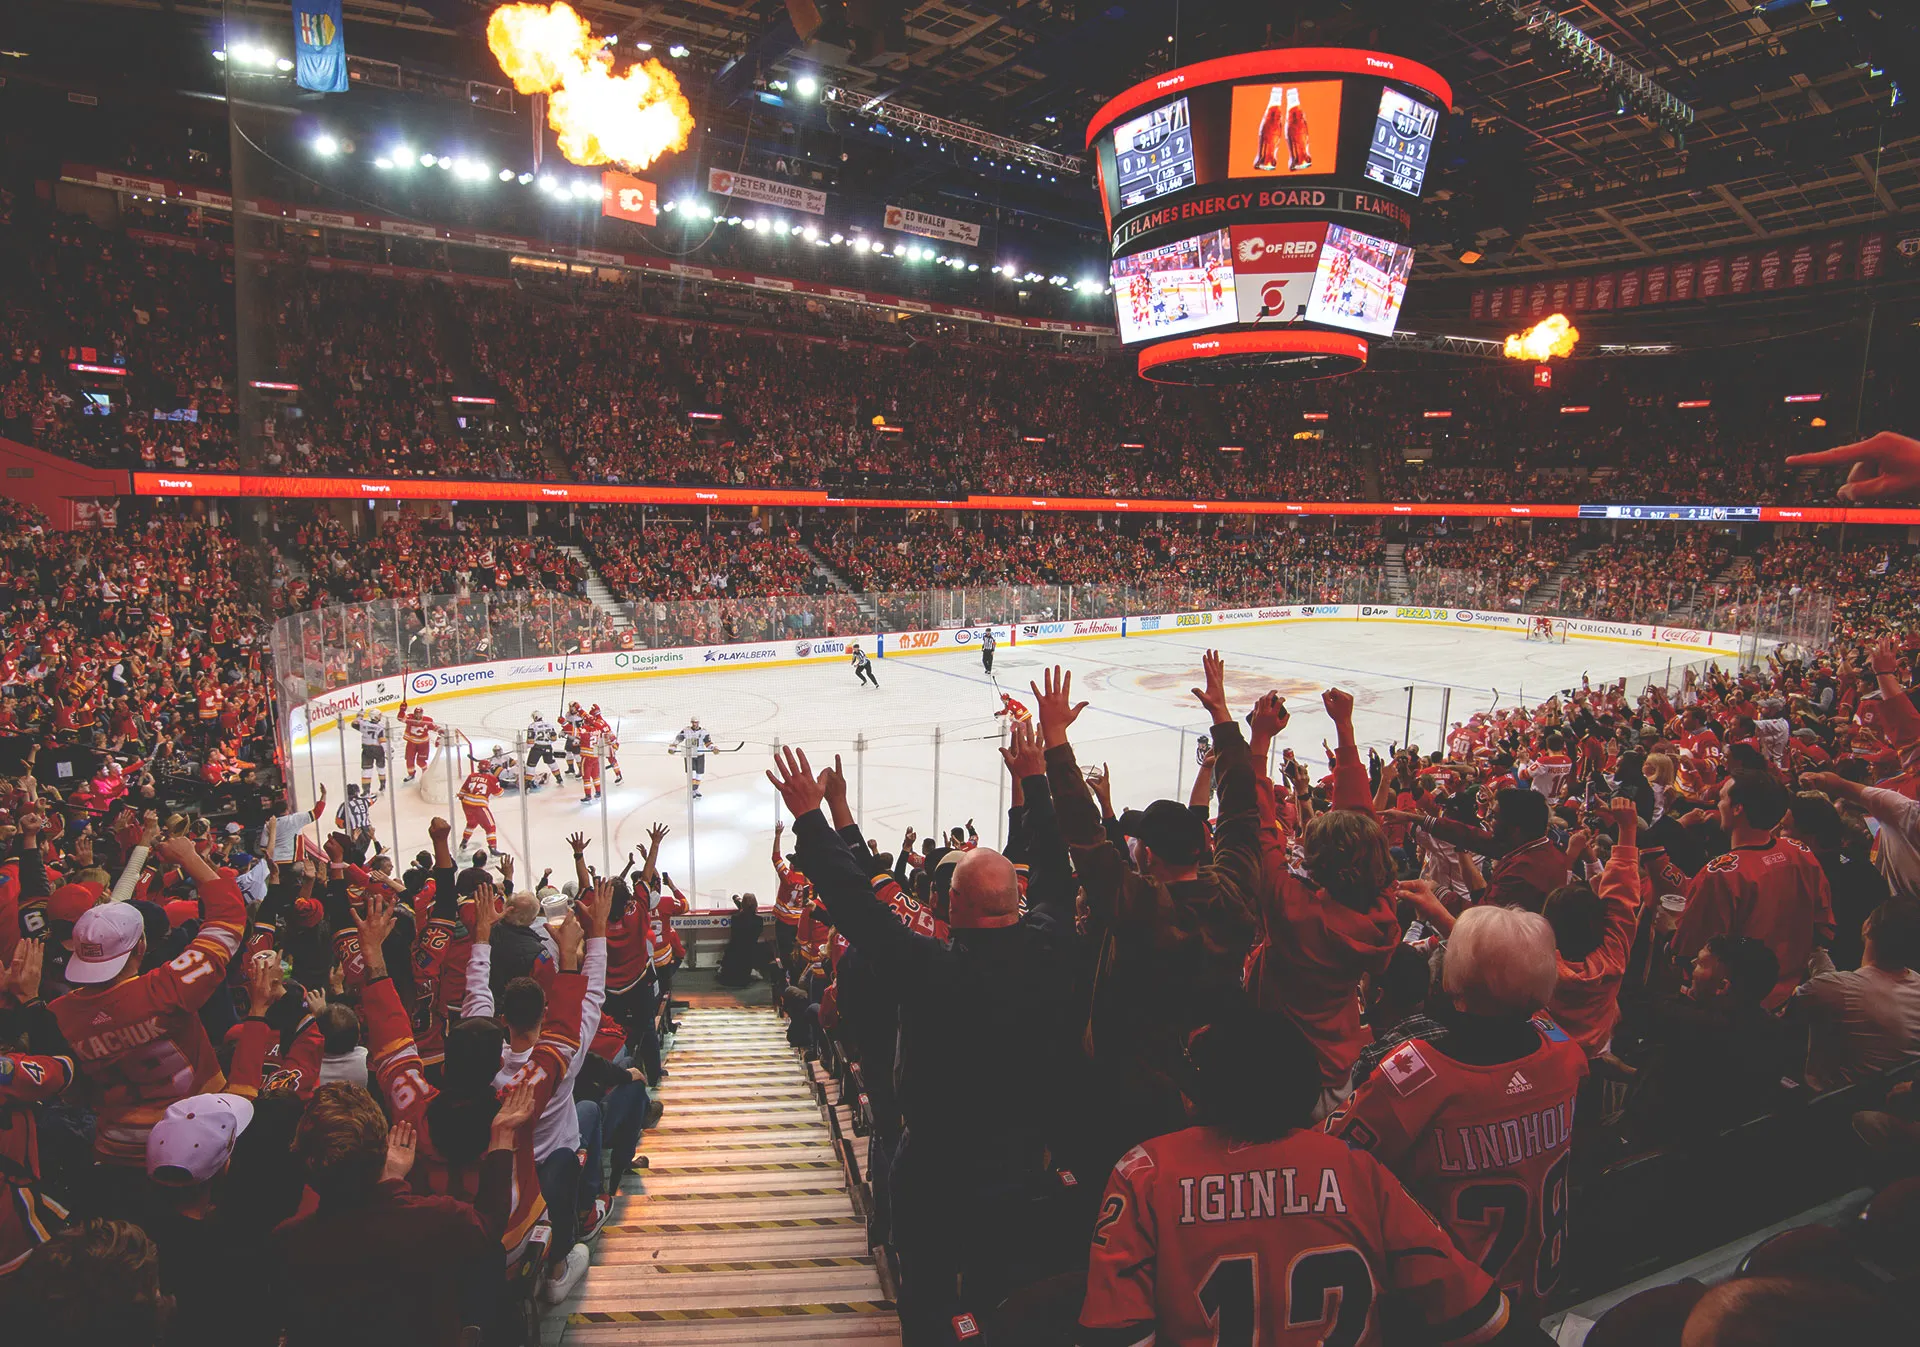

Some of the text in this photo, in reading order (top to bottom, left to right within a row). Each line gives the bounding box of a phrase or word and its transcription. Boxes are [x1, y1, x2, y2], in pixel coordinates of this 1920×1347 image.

[1366, 57, 1394, 70] There's
[1156, 75, 1185, 90] There's
[1397, 114, 1416, 135] 9:17
[1139, 127, 1162, 149] 9:17
[1377, 125, 1386, 143] 0
[1388, 135, 1397, 148] 19
[1398, 141, 1405, 152] 2
[1406, 144, 1415, 156] 13
[1416, 143, 1425, 160] 2
[1123, 157, 1131, 173] 0
[1136, 156, 1146, 169] 19
[1150, 153, 1156, 164] 2
[1160, 146, 1171, 160] 13
[1175, 137, 1184, 154] 2
[734, 176, 802, 199] PETER MAHER
[1155, 177, 1183, 195] $61,660
[1130, 190, 1326, 236] FLAMES ENERGY BOARD
[1355, 194, 1398, 220] FLAMES
[905, 210, 946, 229] ED WHALEN
[903, 223, 930, 235] BROADCAST
[1265, 243, 1283, 254] OF
[1282, 240, 1317, 255] RED
[1192, 339, 1220, 350] There's
[158, 479, 193, 489] There's
[361, 484, 391, 493] There's
[541, 488, 569, 497] There's
[695, 492, 719, 500] There's
[1634, 508, 1642, 517] 0
[1650, 511, 1665, 519] 9:17
[1688, 509, 1696, 518] 2
[1258, 609, 1292, 619] Scotiabank
[1301, 606, 1340, 614] SN NOW
[1396, 608, 1448, 620] PIZZA 73
[1176, 613, 1213, 626] PIZZA 73
[1475, 612, 1511, 623] Supreme
[1022, 624, 1065, 635] SN NOW
[1073, 620, 1118, 635] Tim Hortons
[1580, 623, 1630, 636] ORIGINAL
[1631, 626, 1643, 637] 16
[910, 631, 940, 648] SKIP
[972, 629, 1006, 641] Supeme
[813, 642, 845, 654] CLAMATO
[632, 652, 684, 665] Desjardins
[506, 660, 593, 677] Michelob ULTRA
[415, 668, 495, 689] Esso Supreme
[1704, 746, 1719, 757] 19
[354, 803, 366, 813] 49
[683, 918, 697, 926] GOOD
[697, 918, 711, 926] FOOD
[71, 1015, 169, 1062] KACHUK
[20, 1060, 46, 1085] 4
[1506, 1083, 1533, 1096] adidas
[1178, 1167, 1348, 1225] IGINLA
[1193, 1243, 1377, 1347] 12
